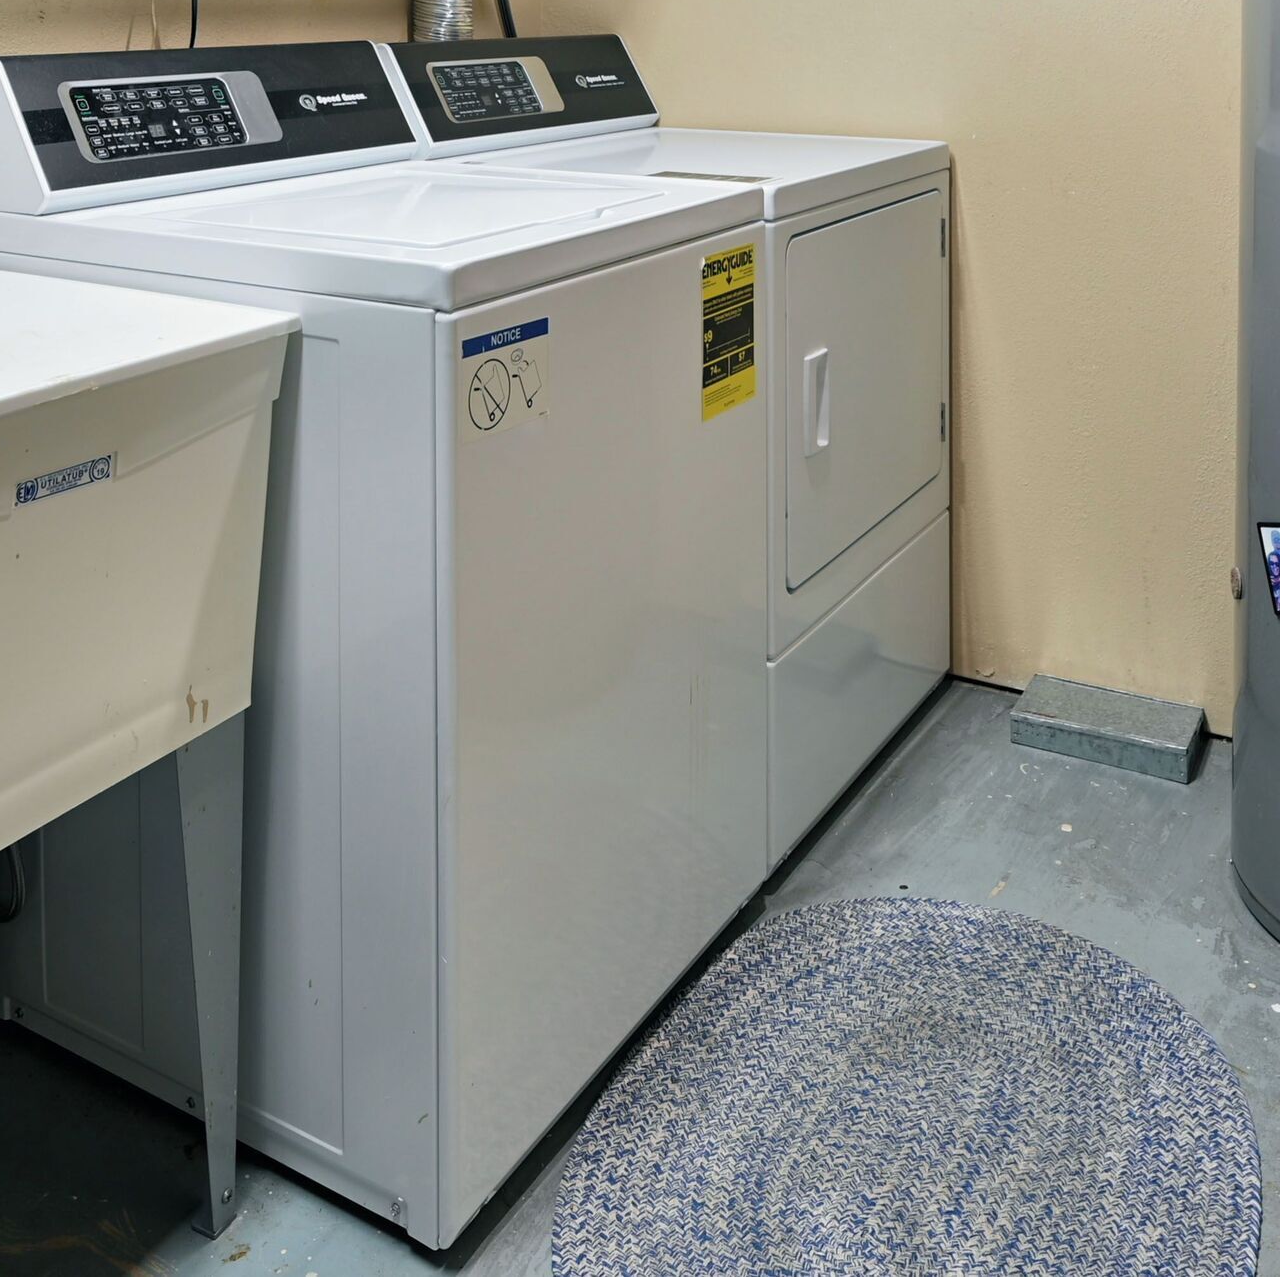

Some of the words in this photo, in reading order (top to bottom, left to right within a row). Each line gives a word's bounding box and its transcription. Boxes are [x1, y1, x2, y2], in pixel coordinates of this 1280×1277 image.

[316, 93, 342, 105] Speed
[702, 249, 753, 280] ENERGYGUIDE
[490, 327, 521, 347] NOTICE
[704, 330, 713, 343] $9
